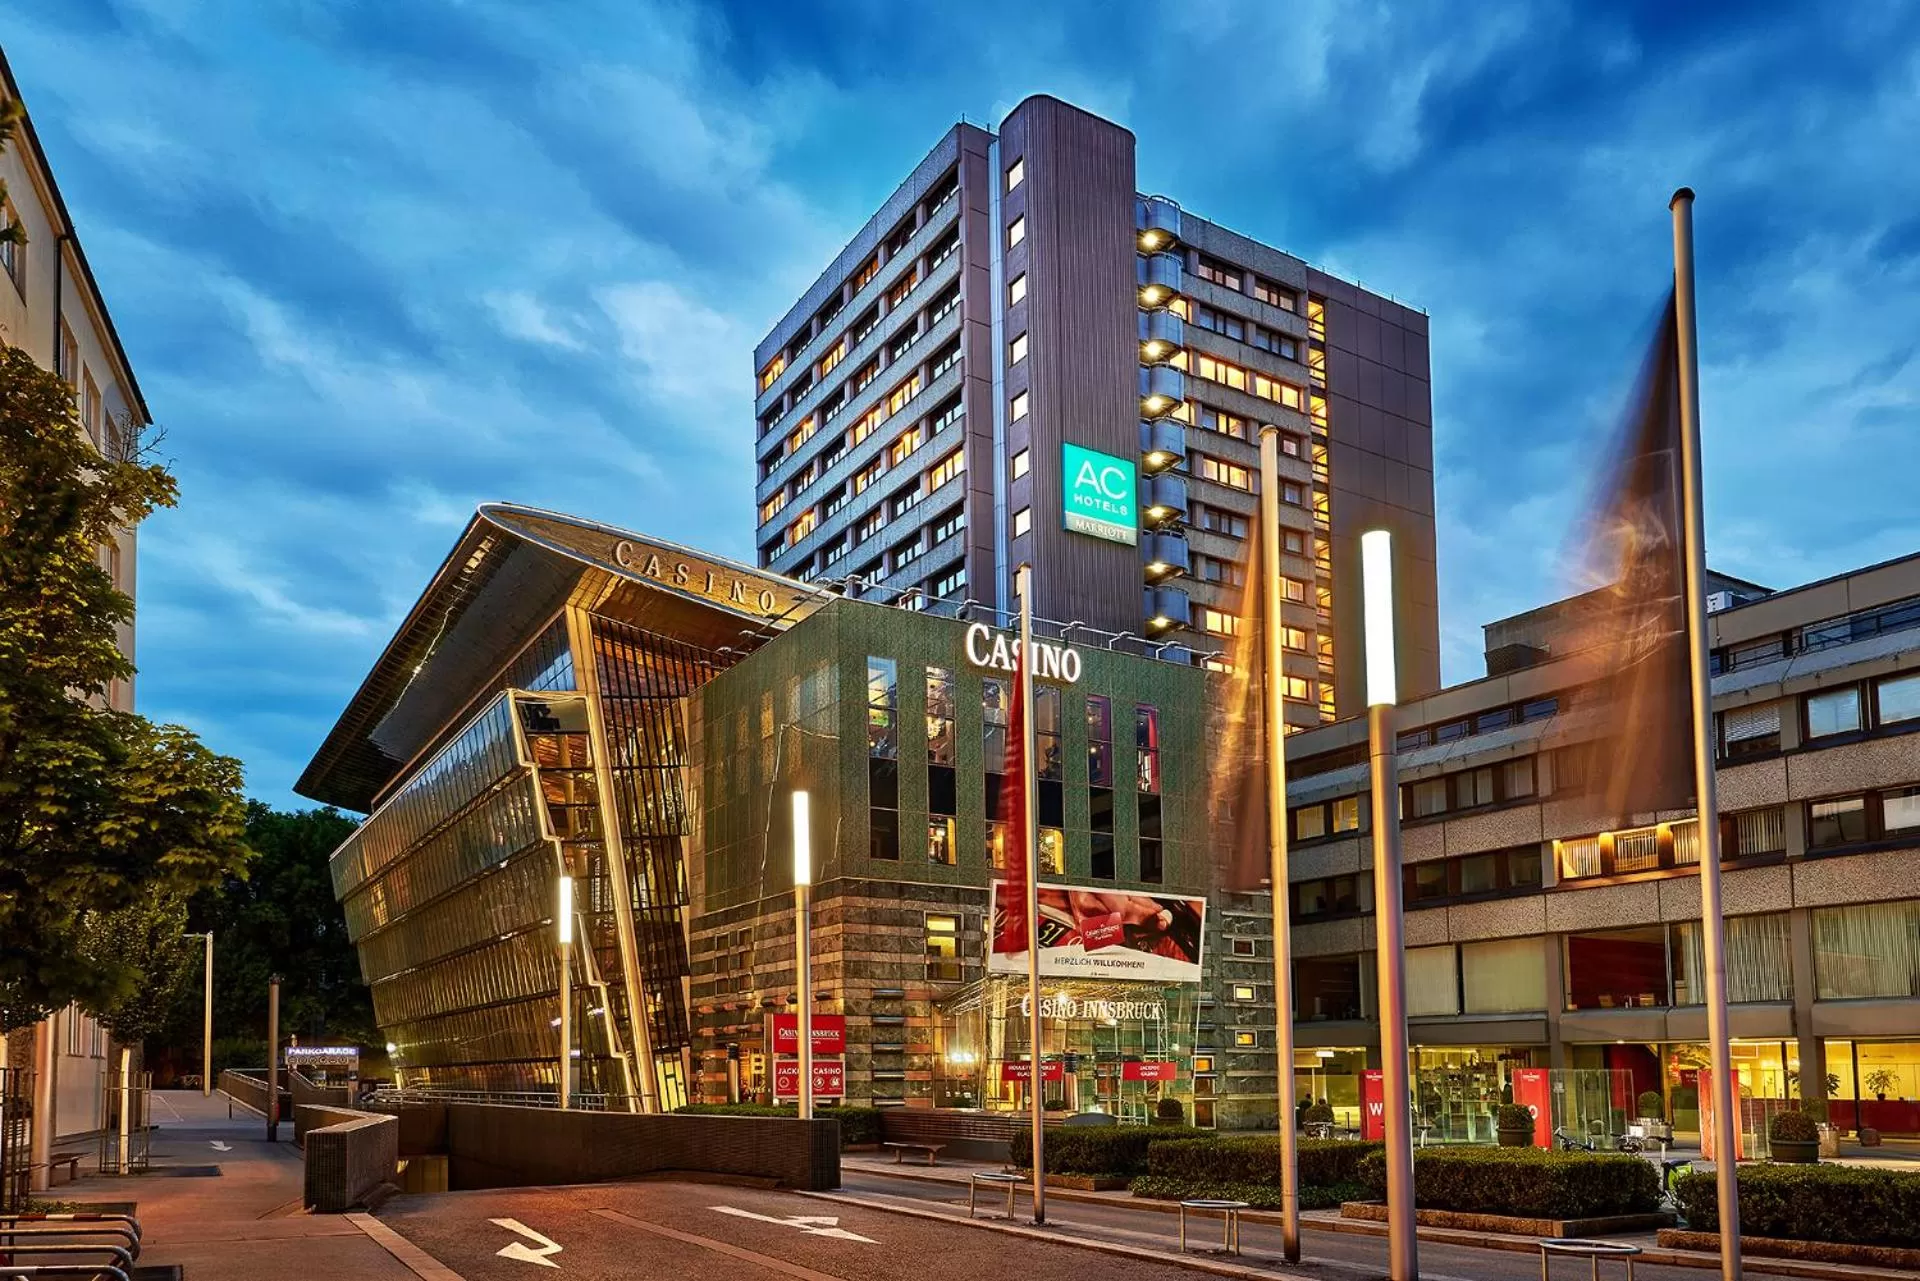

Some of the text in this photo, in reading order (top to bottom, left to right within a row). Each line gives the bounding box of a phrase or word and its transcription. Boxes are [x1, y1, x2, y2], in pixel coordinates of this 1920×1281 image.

[1074, 460, 1127, 500] AC
[1073, 493, 1128, 516] HOTELS
[1075, 520, 1127, 540] MARRIOTT
[614, 540, 775, 613] CASINO
[1054, 956, 1146, 970] HERZLICH WILLKOMMEN!
[1022, 992, 1161, 1020] CSINO INNSBRUCK
[288, 1047, 357, 1055] PARKGARAGE
[813, 1067, 842, 1075] CASINO
